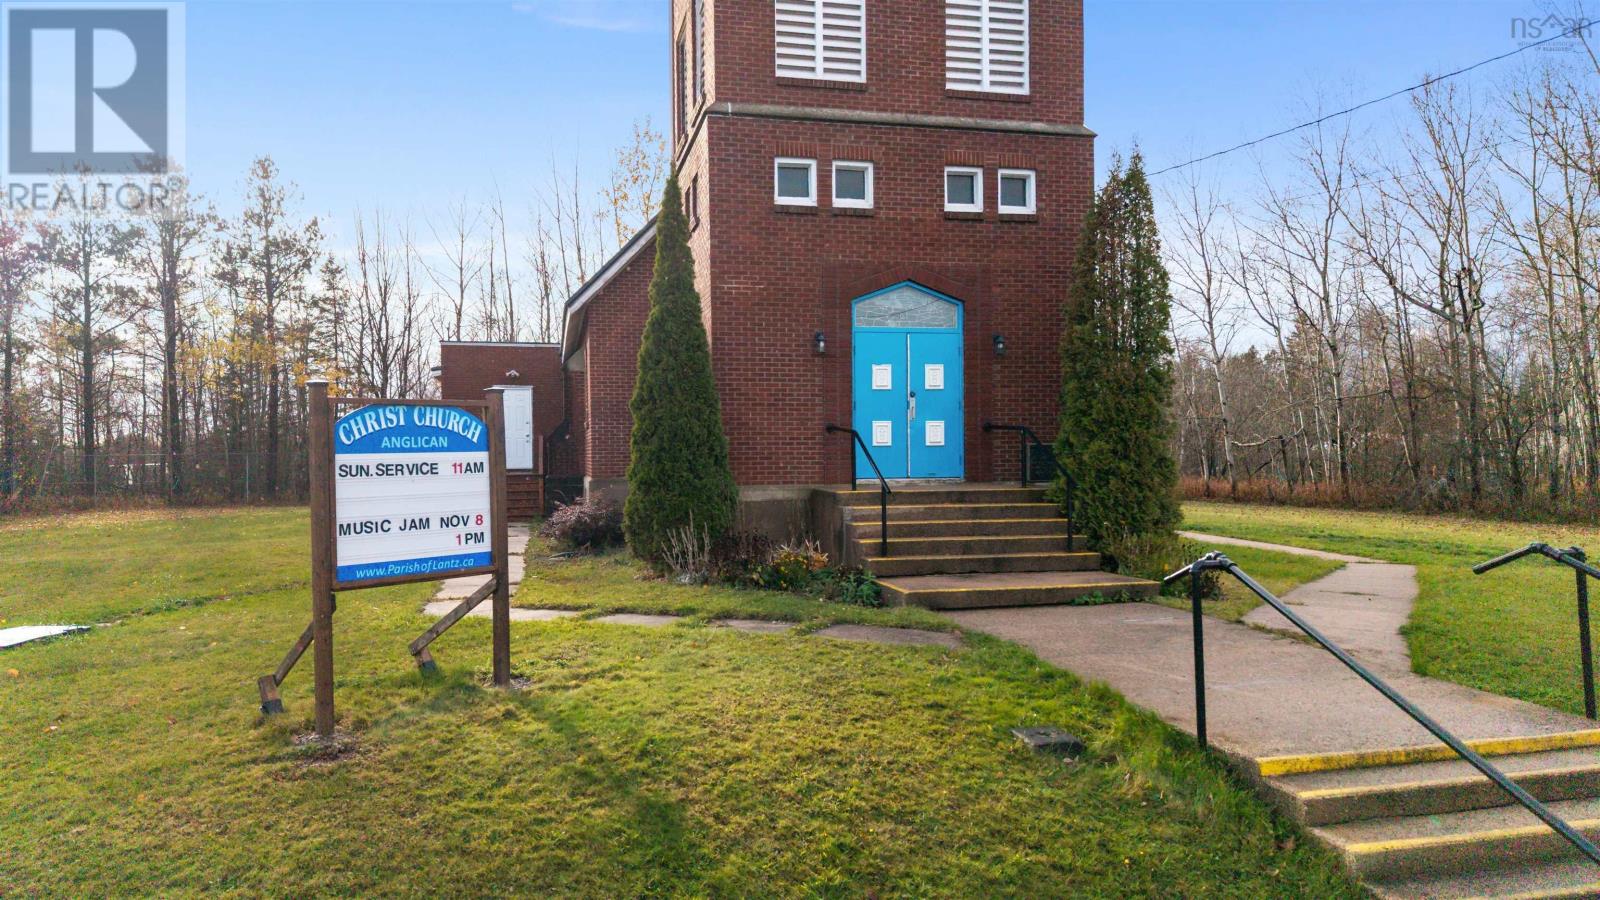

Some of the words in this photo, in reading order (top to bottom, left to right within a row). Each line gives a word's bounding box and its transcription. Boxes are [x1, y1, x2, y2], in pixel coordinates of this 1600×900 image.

[338, 405, 407, 446] CHRIST
[413, 405, 482, 443] CHURCH
[381, 436, 448, 449] ANGLICAN
[451, 461, 485, 475] 11AM
[338, 519, 392, 537] MUSIC
[399, 517, 430, 531] JAM
[440, 515, 470, 529] NOV
[475, 514, 484, 526] 8
[355, 558, 475, 578] www.ParishofLantz.ca
